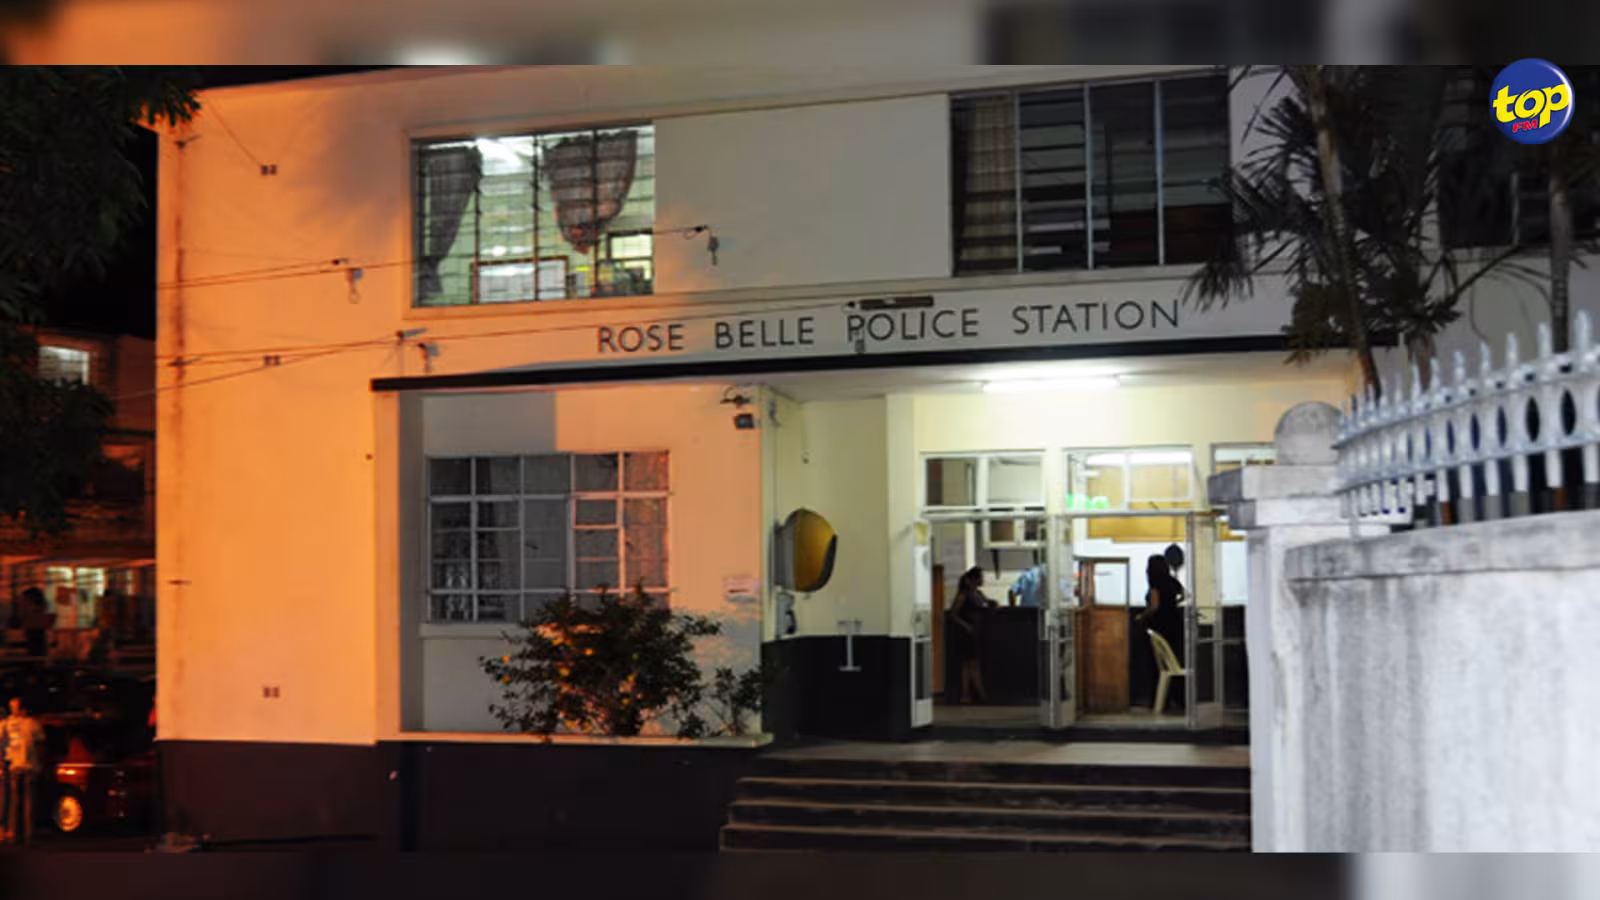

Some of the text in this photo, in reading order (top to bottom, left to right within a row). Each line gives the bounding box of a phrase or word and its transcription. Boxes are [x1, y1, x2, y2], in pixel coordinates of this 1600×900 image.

[597, 299, 1179, 353] ROSE BELLE POLICE STATION
